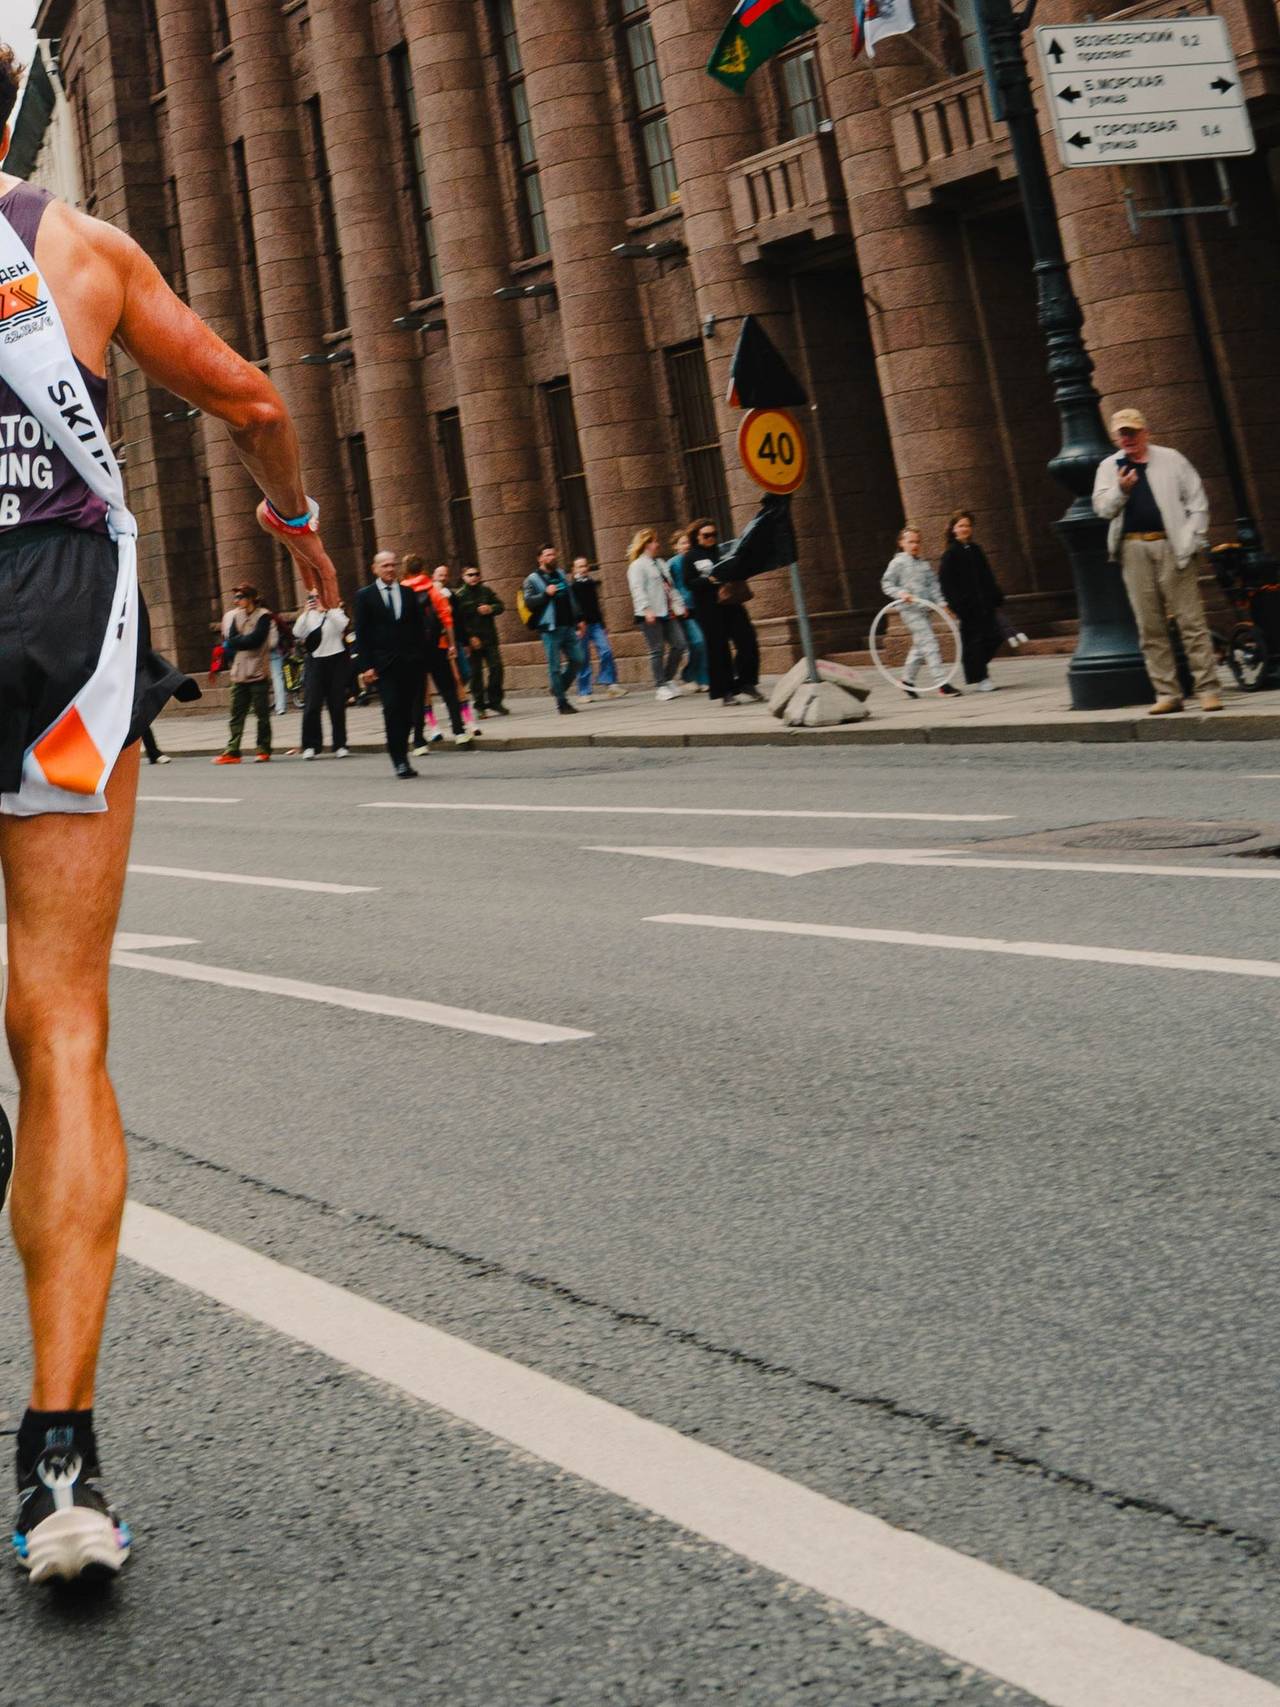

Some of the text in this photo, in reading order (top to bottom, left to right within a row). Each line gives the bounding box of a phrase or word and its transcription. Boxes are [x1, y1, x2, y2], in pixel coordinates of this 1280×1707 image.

[1074, 28, 1174, 48] ВОЗНЕСЕНСКИЙ
[1093, 119, 1178, 136] ГОРОХОВАЯ
[758, 432, 795, 465] 40
